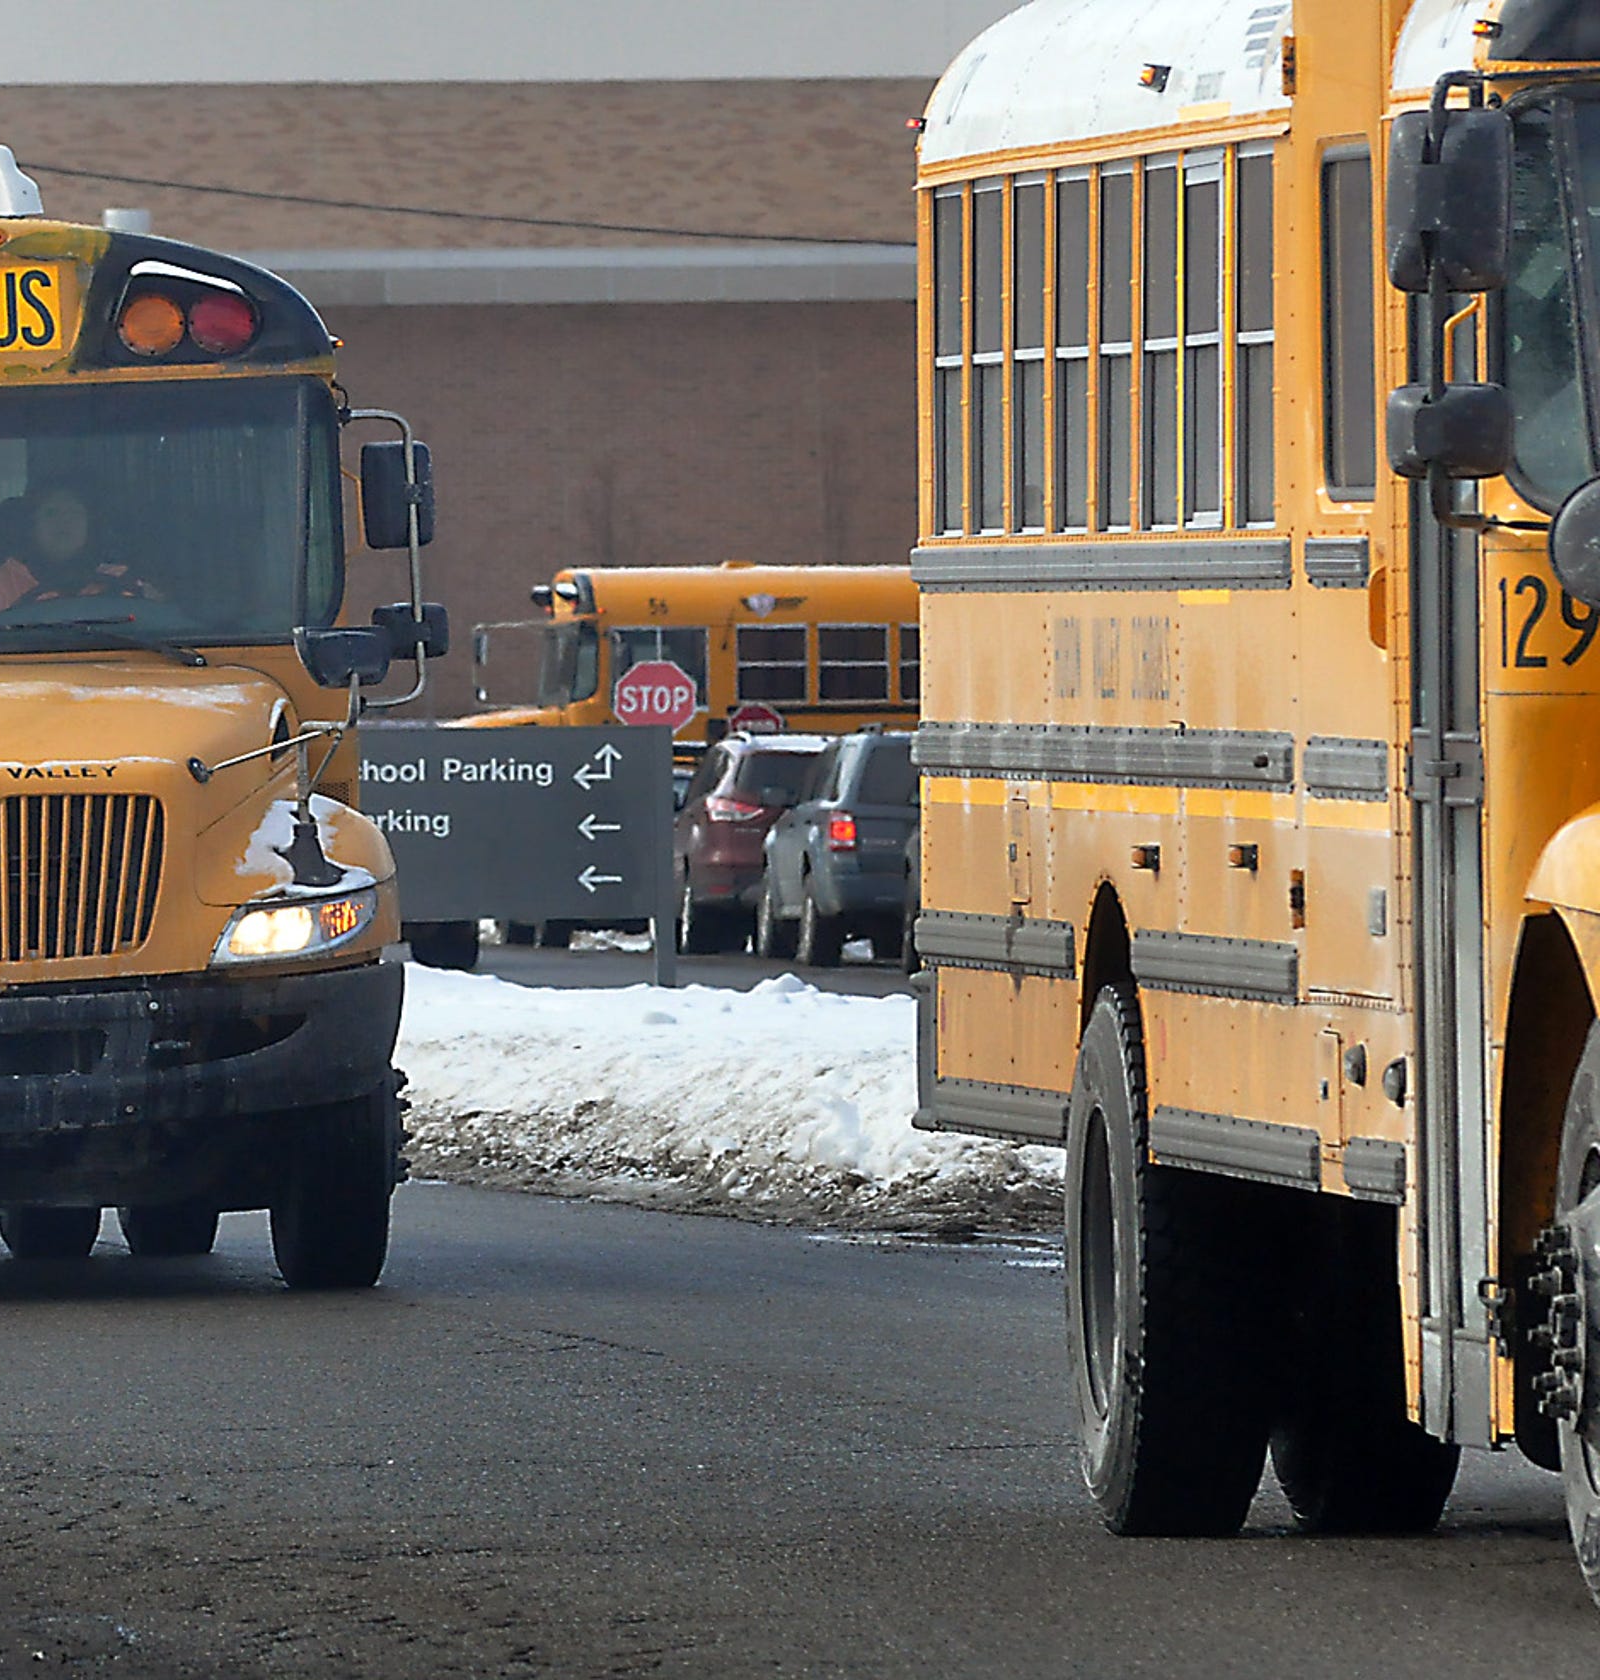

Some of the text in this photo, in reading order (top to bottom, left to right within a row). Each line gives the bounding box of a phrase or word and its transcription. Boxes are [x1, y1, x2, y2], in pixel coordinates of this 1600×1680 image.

[1498, 575, 1599, 668] 129
[621, 685, 690, 714] STOP
[6, 764, 117, 779] VALLEY
[358, 758, 553, 787] hool Parking
[365, 809, 450, 838] rking
